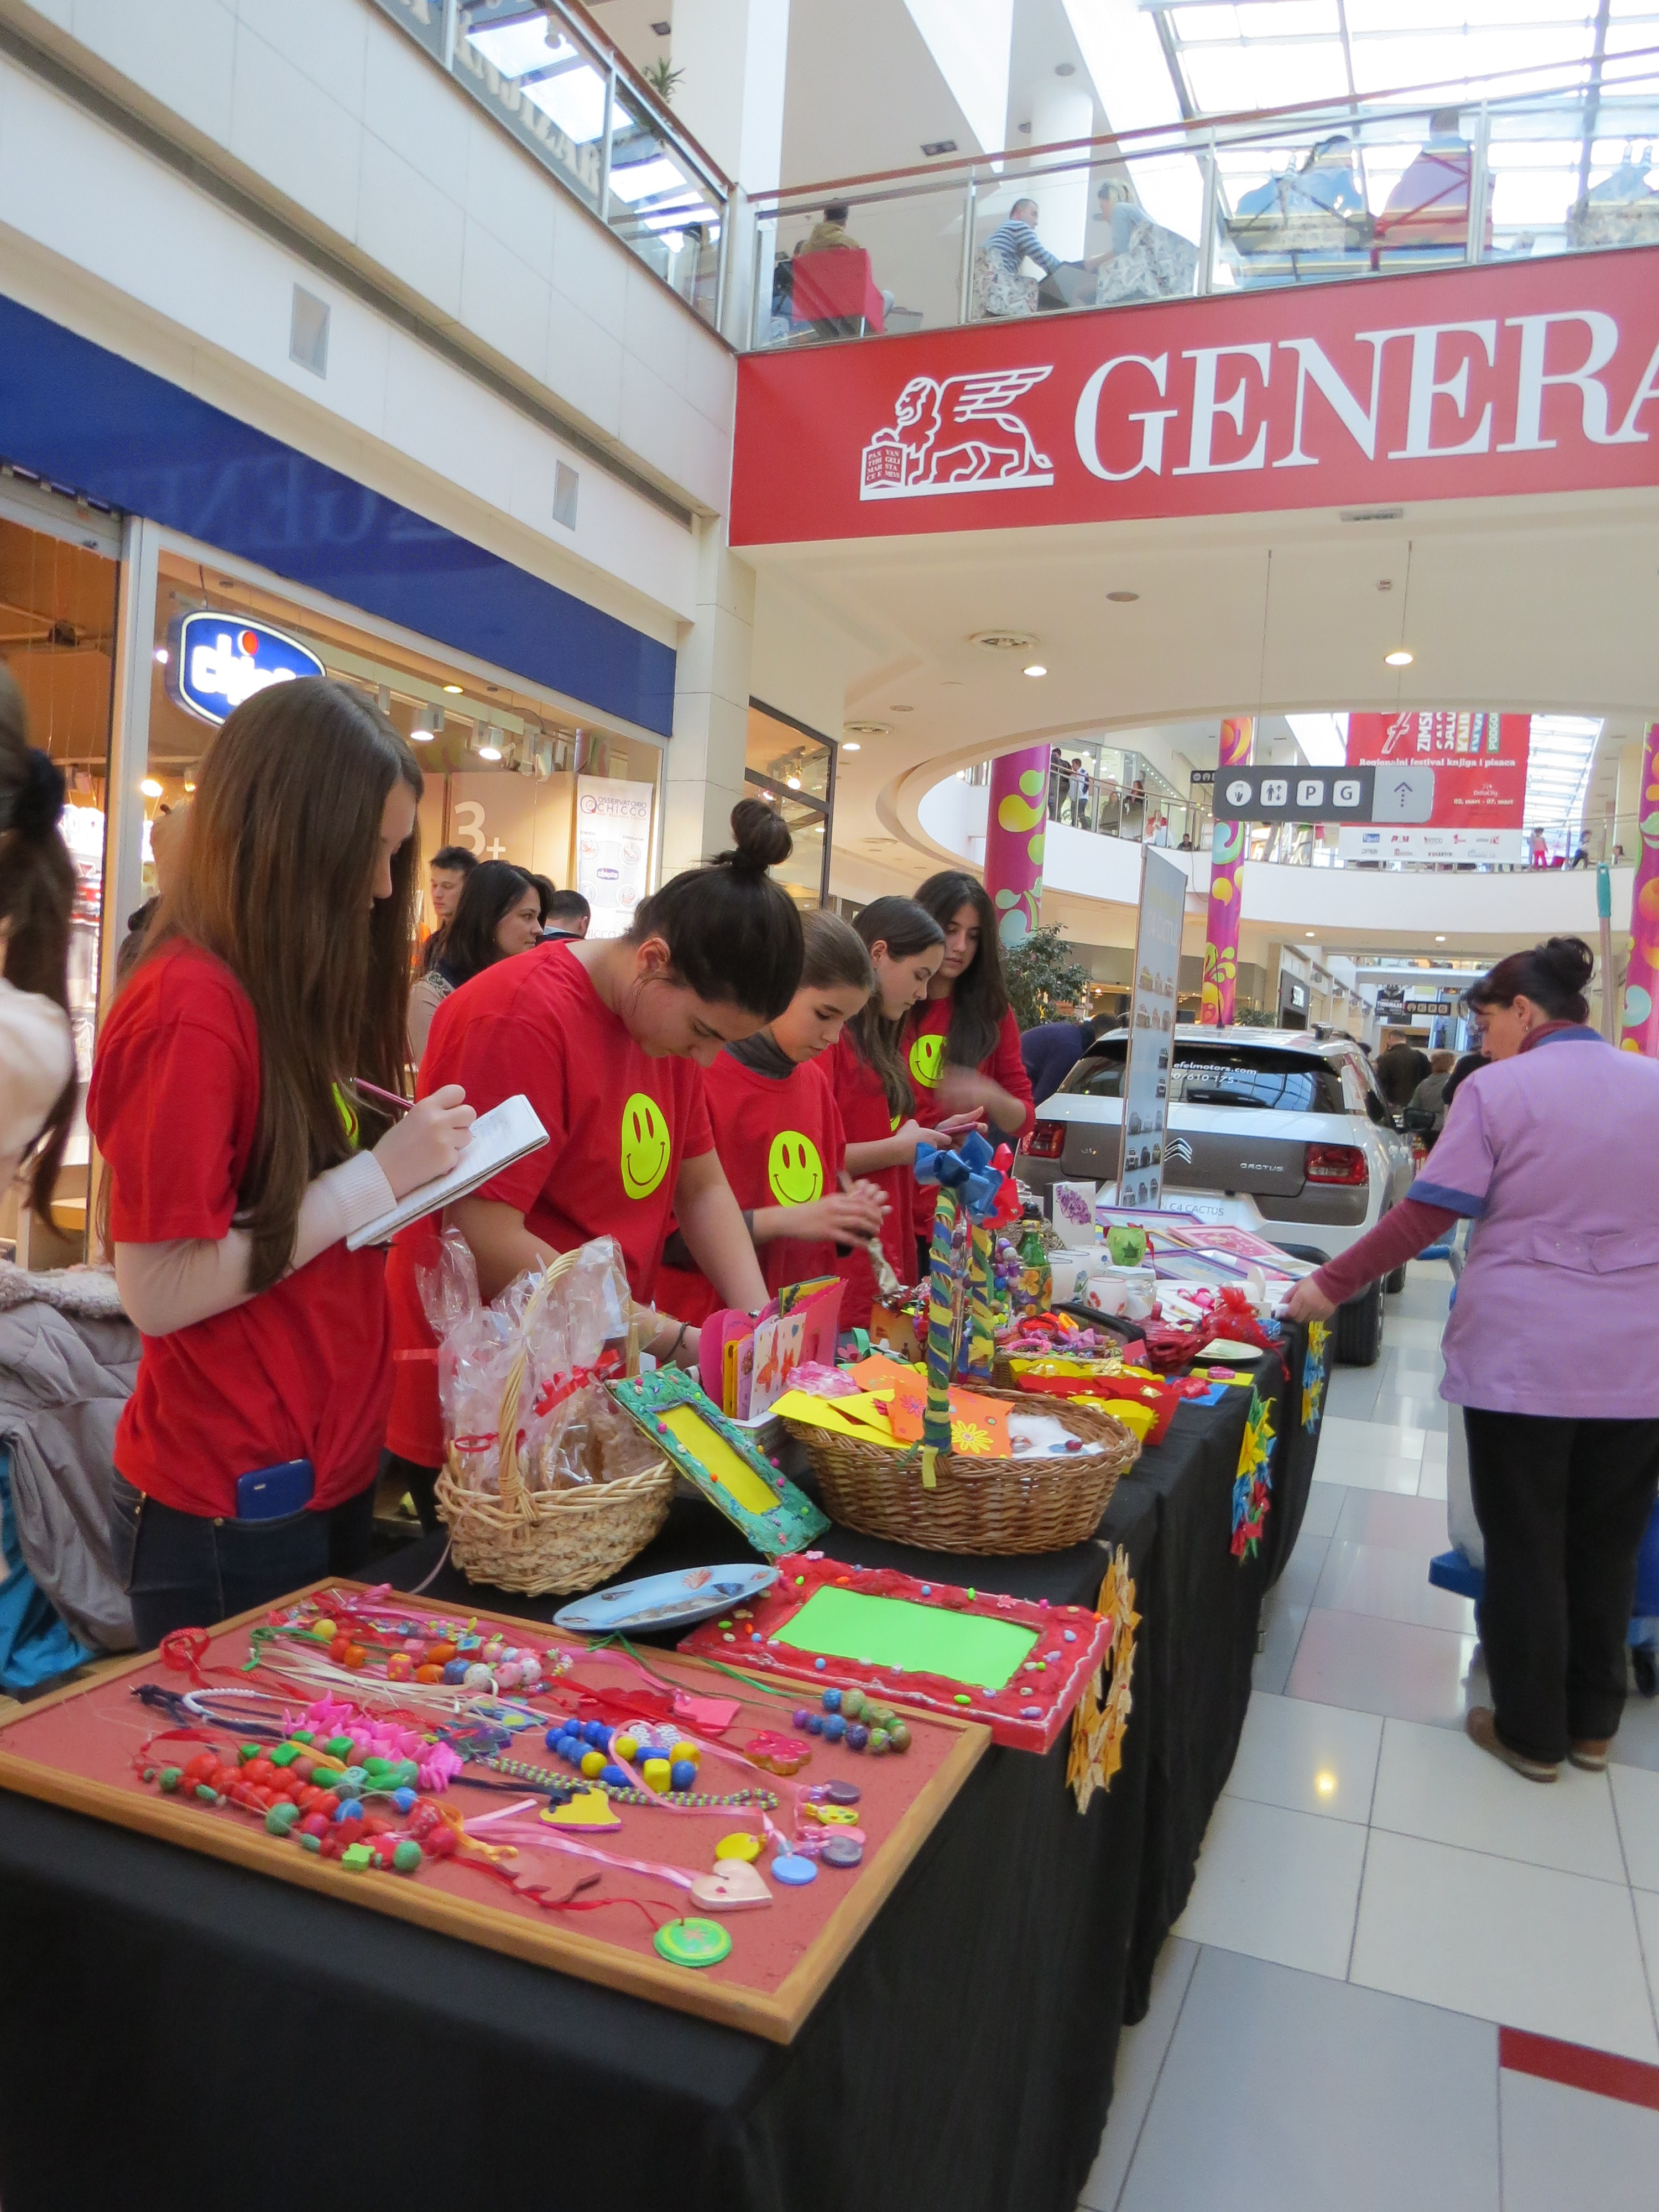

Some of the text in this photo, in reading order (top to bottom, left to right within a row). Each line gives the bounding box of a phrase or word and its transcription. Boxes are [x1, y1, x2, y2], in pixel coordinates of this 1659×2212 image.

[1411, 758, 1445, 766] festival
[1447, 758, 1477, 768] knjiga
[1484, 758, 1516, 768] pisaca
[1306, 786, 1316, 800] P
[1340, 786, 1353, 800] G
[597, 796, 647, 808] OSSERVATORIO
[597, 803, 646, 817] CHICCO
[597, 868, 618, 879] chicco
[1213, 1074, 1234, 1084] 175
[1240, 1162, 1284, 1172] CACTUS
[1170, 1202, 1182, 1212] C4
[1185, 1204, 1224, 1216] CACTUS
